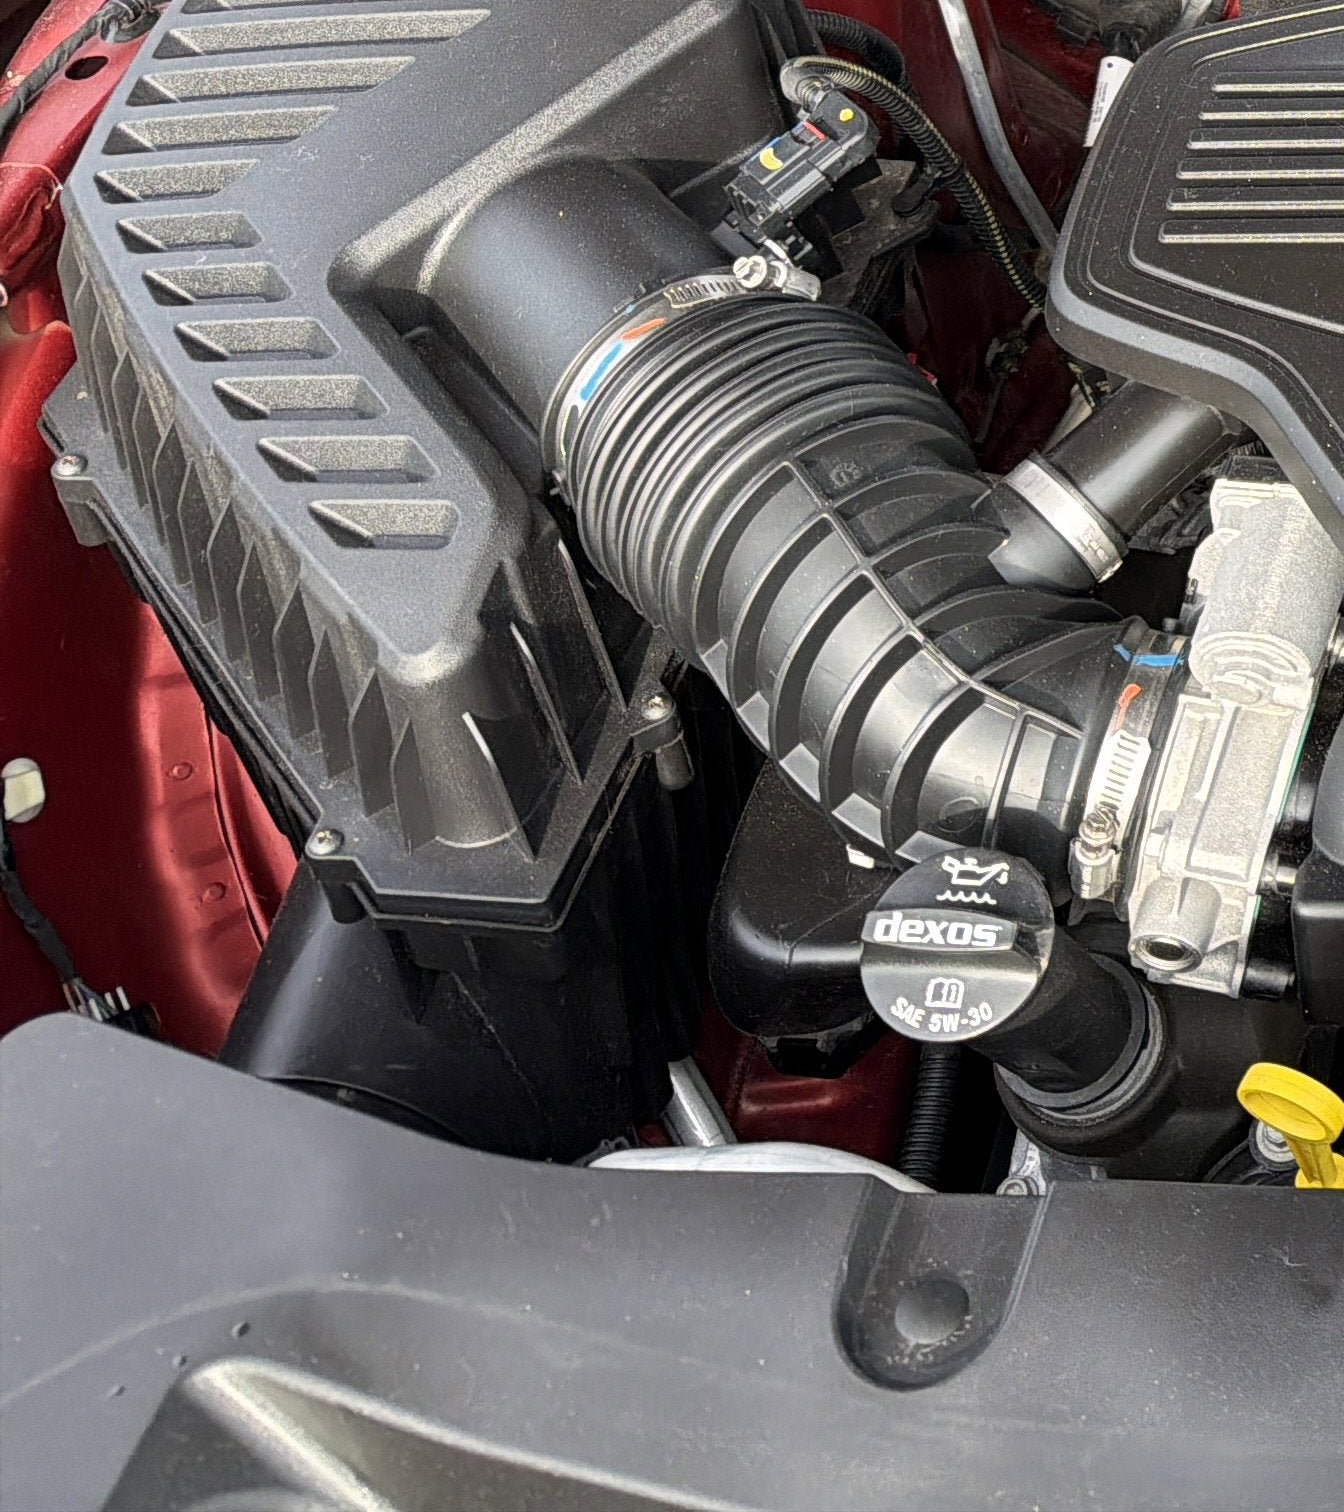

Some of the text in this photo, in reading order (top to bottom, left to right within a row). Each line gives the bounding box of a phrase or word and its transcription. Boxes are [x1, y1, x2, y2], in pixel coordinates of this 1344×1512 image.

[873, 911, 998, 948] dexos
[890, 995, 993, 1034] SAE 5W-30
